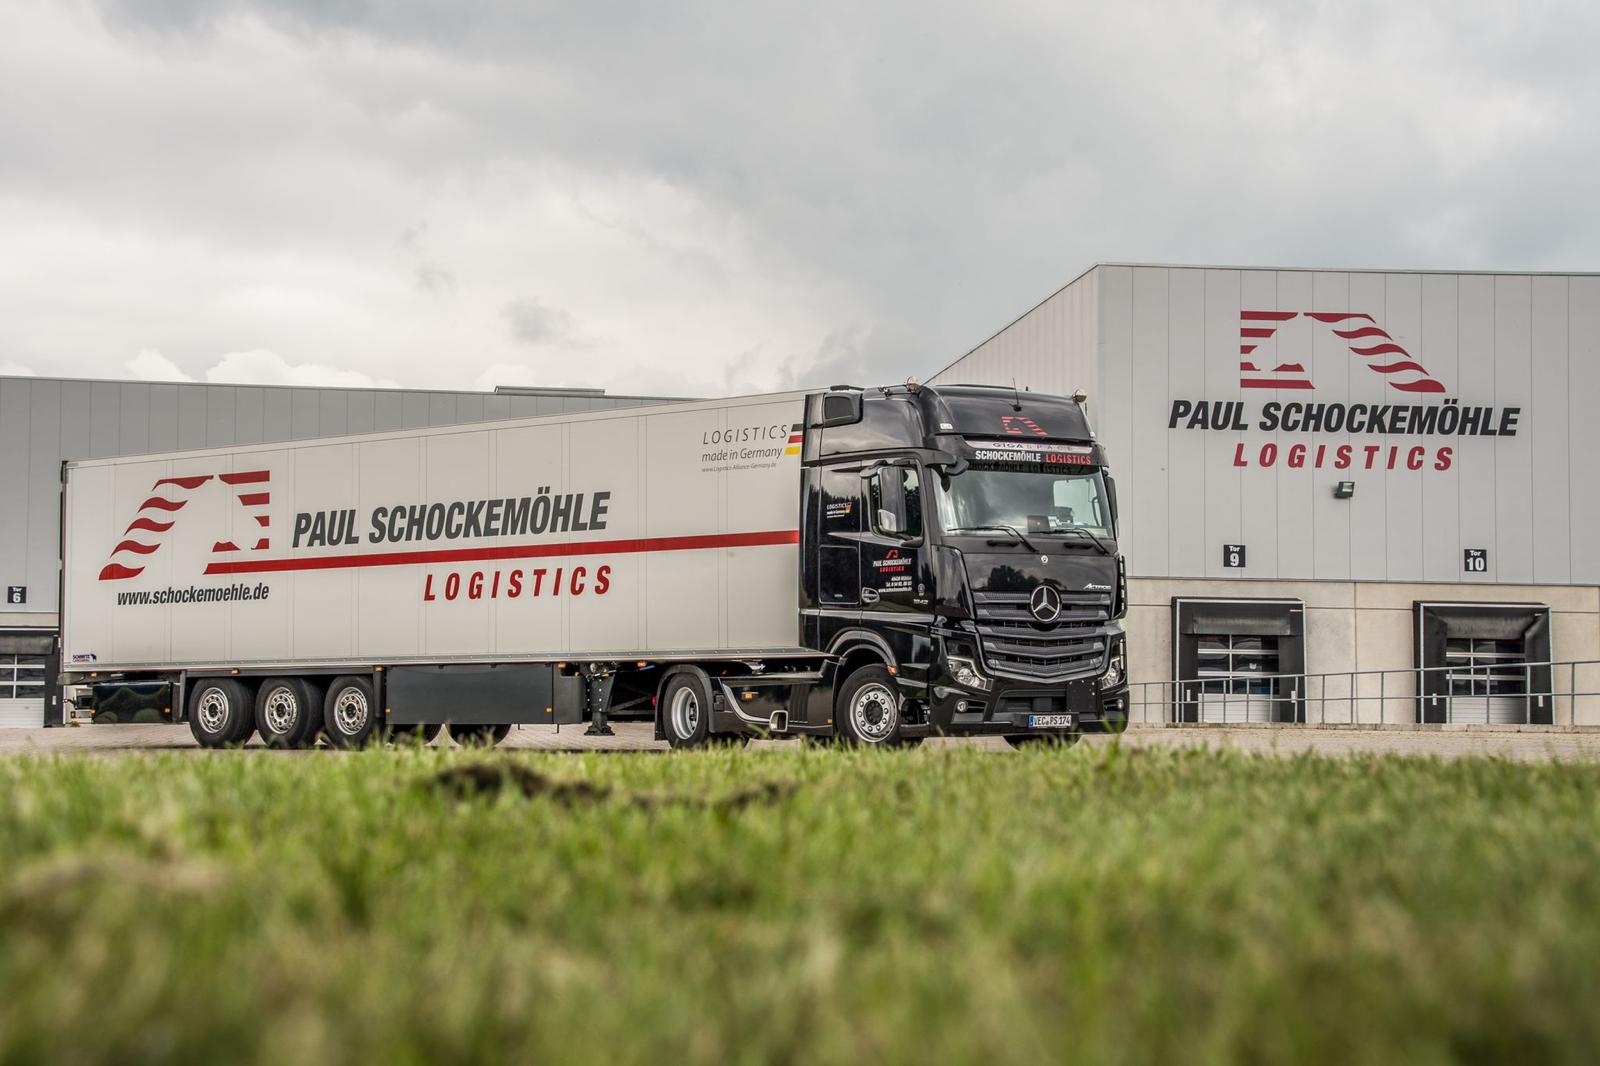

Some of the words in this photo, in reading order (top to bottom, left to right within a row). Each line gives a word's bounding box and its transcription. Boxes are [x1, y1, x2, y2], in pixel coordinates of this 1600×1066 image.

[1168, 400, 1248, 431] PAUL
[1259, 398, 1521, 436] SCHOCKEMÖHLE
[703, 424, 787, 445] LOGISTICS
[702, 449, 728, 462] made
[729, 449, 738, 460] in
[740, 447, 783, 459] Germany
[975, 450, 1041, 462] SCHOCKEMÖHLE
[1045, 454, 1092, 465] LOGISTICS
[1233, 443, 1453, 471] LOGISTICS
[292, 509, 360, 548] PAUL
[369, 486, 611, 544] SCHOCKEMÖHLE
[1230, 552, 1240, 566] 9
[1467, 557, 1485, 571] 10
[117, 582, 269, 606] www.schockemoehle.de
[423, 565, 611, 602] LOGISTICS
[13, 592, 21, 603] 6
